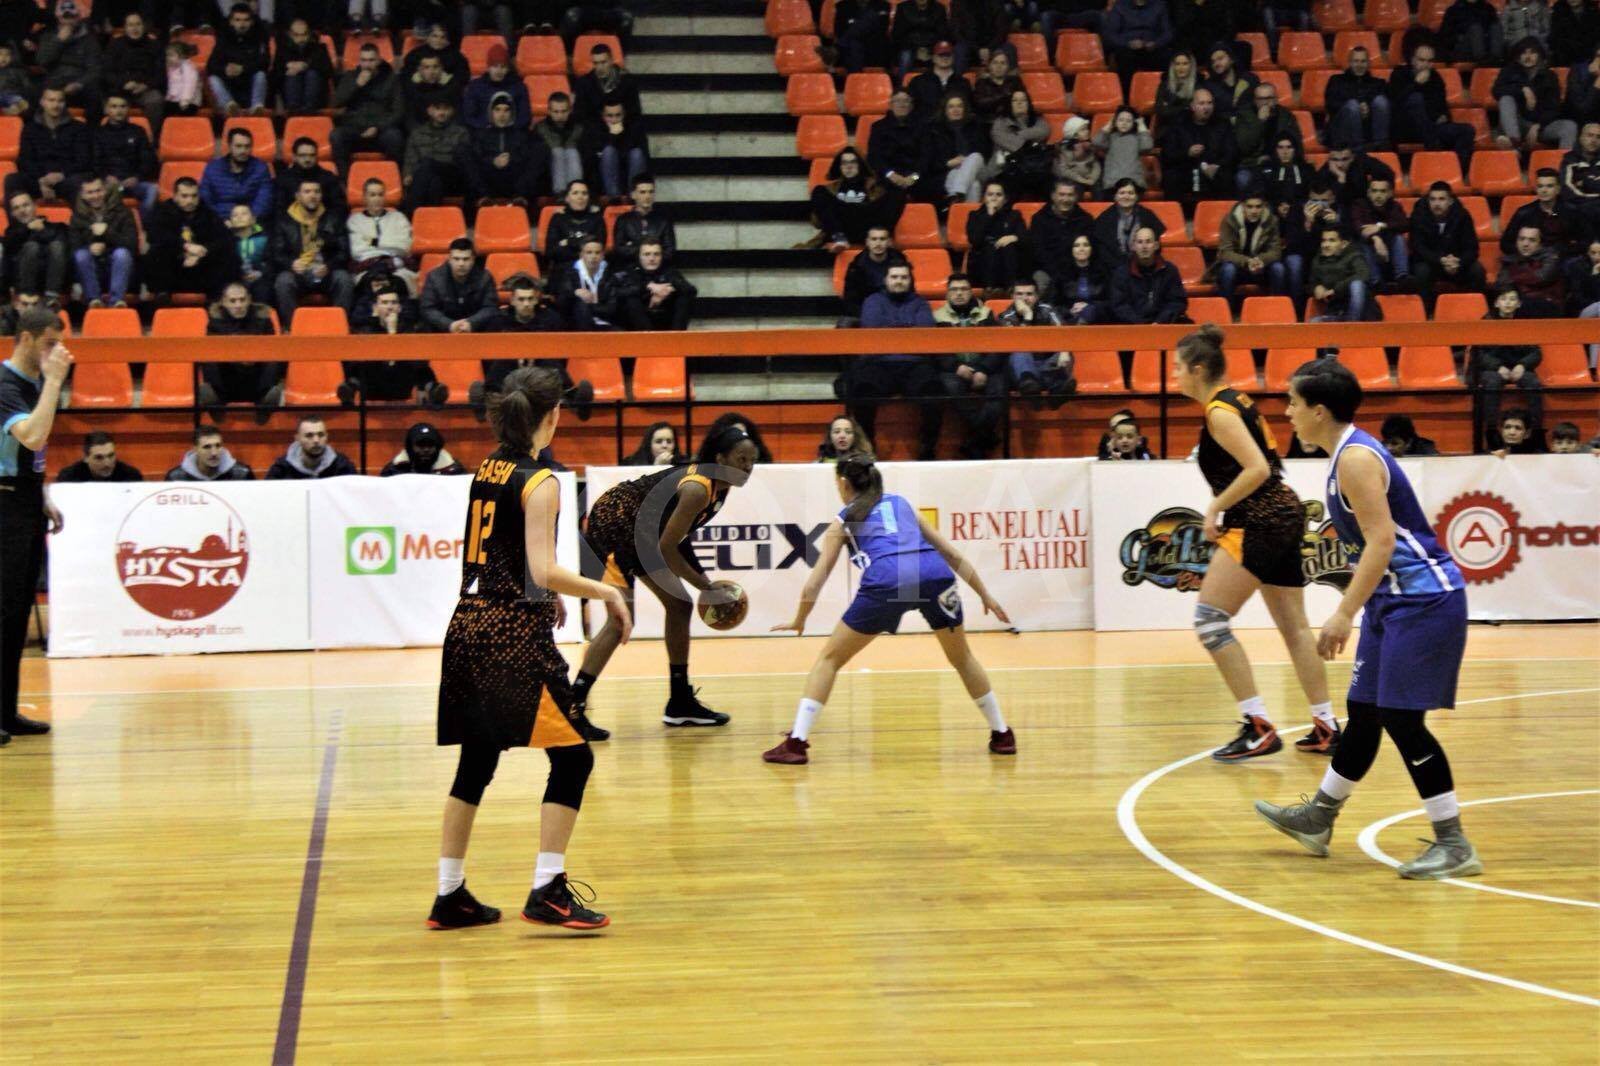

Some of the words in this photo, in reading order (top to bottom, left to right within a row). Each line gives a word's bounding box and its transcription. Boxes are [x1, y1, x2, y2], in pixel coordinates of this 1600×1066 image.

[475, 458, 517, 485] GASHI
[156, 494, 209, 505] GRILL
[466, 499, 496, 565] 12
[692, 525, 770, 541] TUDIO
[950, 509, 1088, 540] RENELUAL
[360, 541, 383, 560] M
[402, 533, 464, 559] Mer
[691, 522, 832, 570] ELIX
[1000, 540, 1089, 570] TAHIRI
[1301, 538, 1347, 578] old
[124, 556, 243, 587] HYSKA
[121, 624, 244, 639] www.hyskagrill.com
